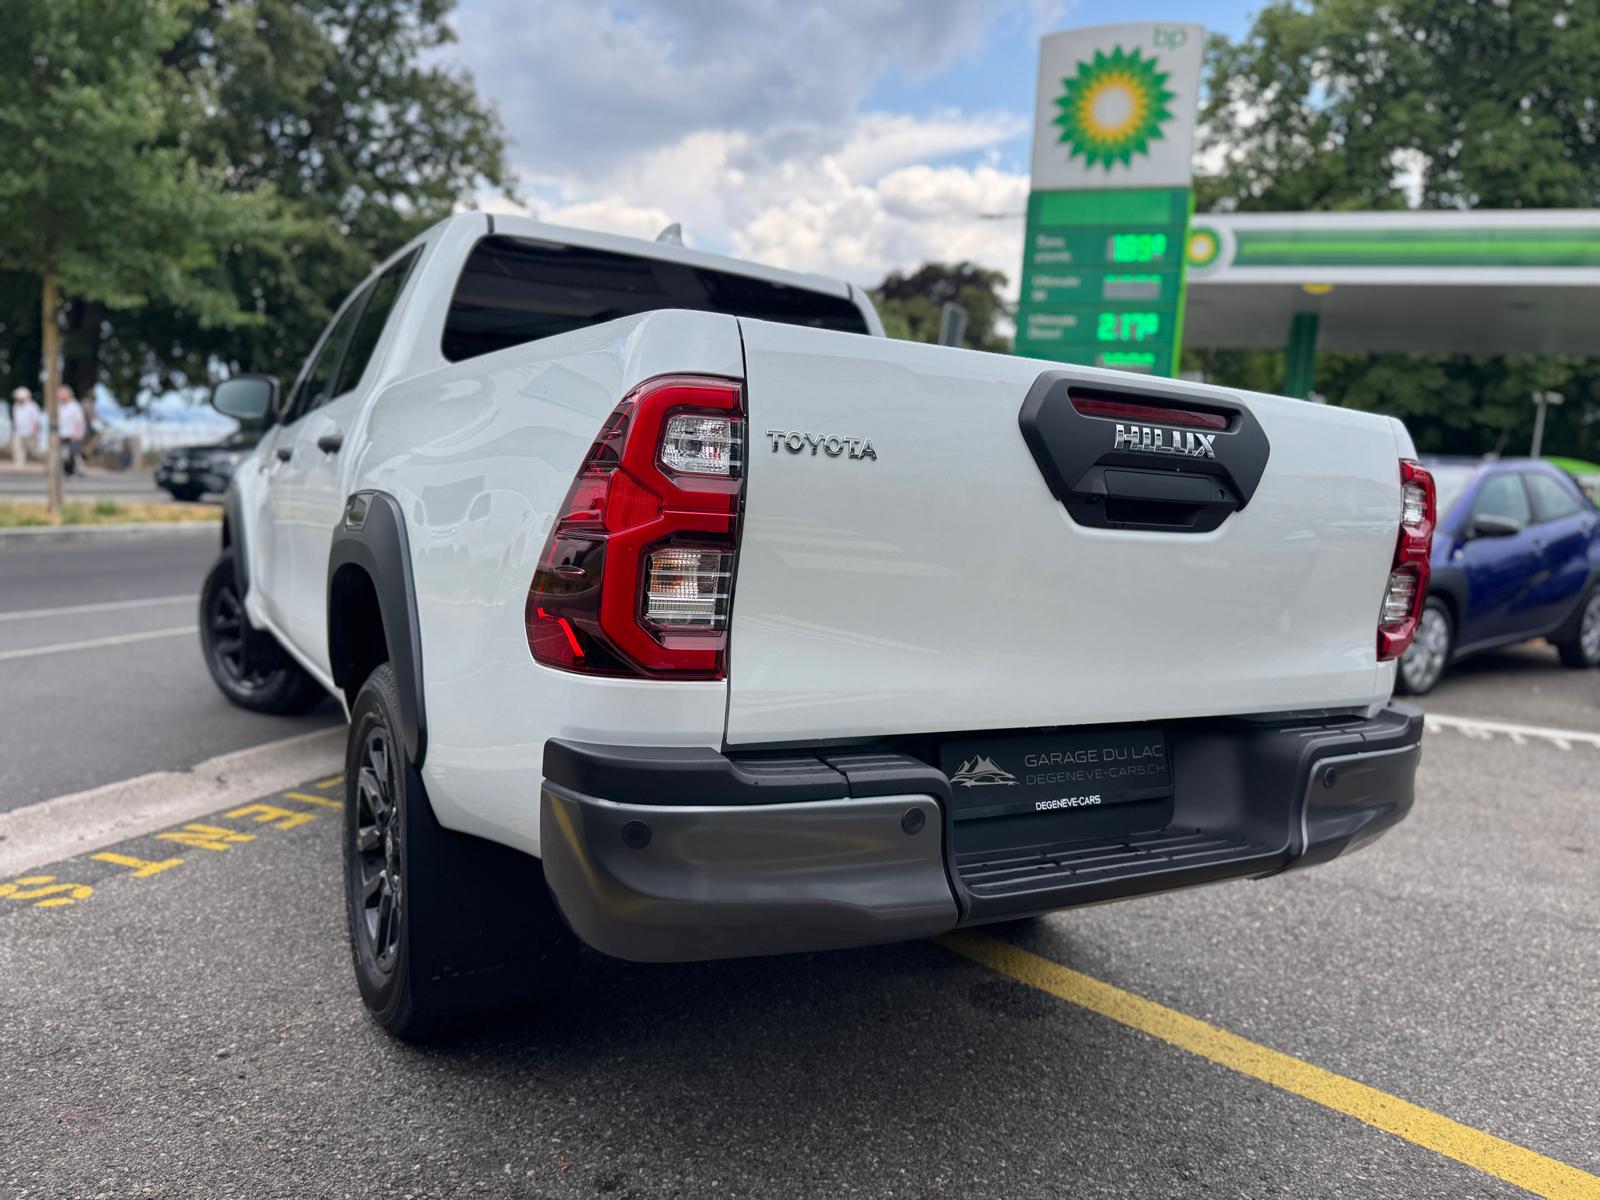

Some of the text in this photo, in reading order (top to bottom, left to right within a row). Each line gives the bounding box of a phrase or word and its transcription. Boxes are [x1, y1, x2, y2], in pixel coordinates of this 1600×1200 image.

[1153, 25, 1188, 50] bp
[766, 428, 877, 461] TOYOTA
[1114, 424, 1216, 459] HILUX
[1024, 745, 1164, 767] GARAGE DU LAC
[1035, 794, 1102, 811] DEGENEVE-CARS
